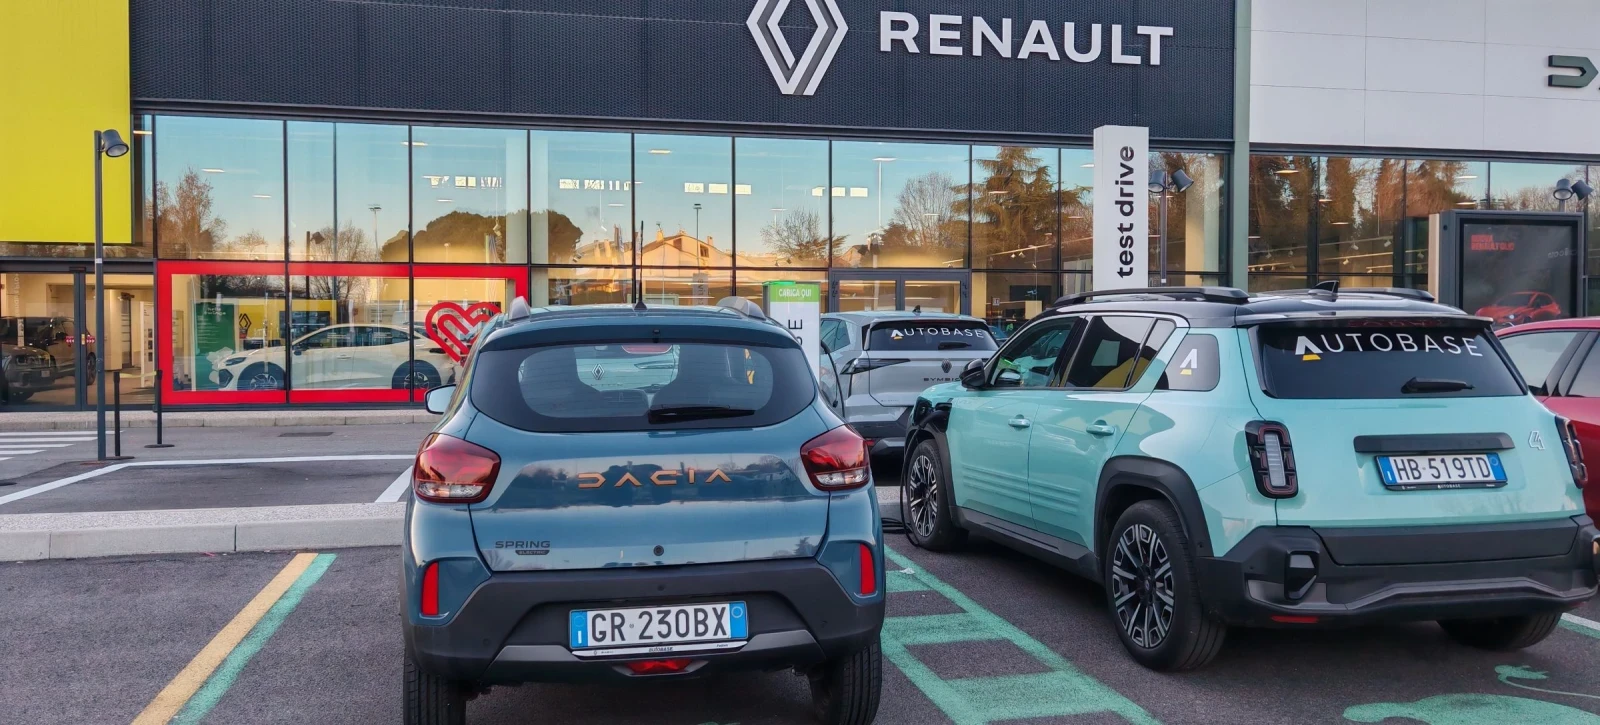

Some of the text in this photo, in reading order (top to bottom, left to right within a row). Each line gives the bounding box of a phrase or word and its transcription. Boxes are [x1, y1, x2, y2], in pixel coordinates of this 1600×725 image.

[880, 11, 1174, 65] RENAULT
[1115, 145, 1134, 279] test drive
[801, 288, 812, 298] QUI
[891, 327, 984, 340] AUTOBASE
[1295, 333, 1483, 361] AUTOBASE
[578, 468, 732, 489] DACIA
[1394, 457, 1491, 481] HB 519TD
[495, 540, 551, 549] SPRING
[591, 607, 727, 642] GR 230BX
